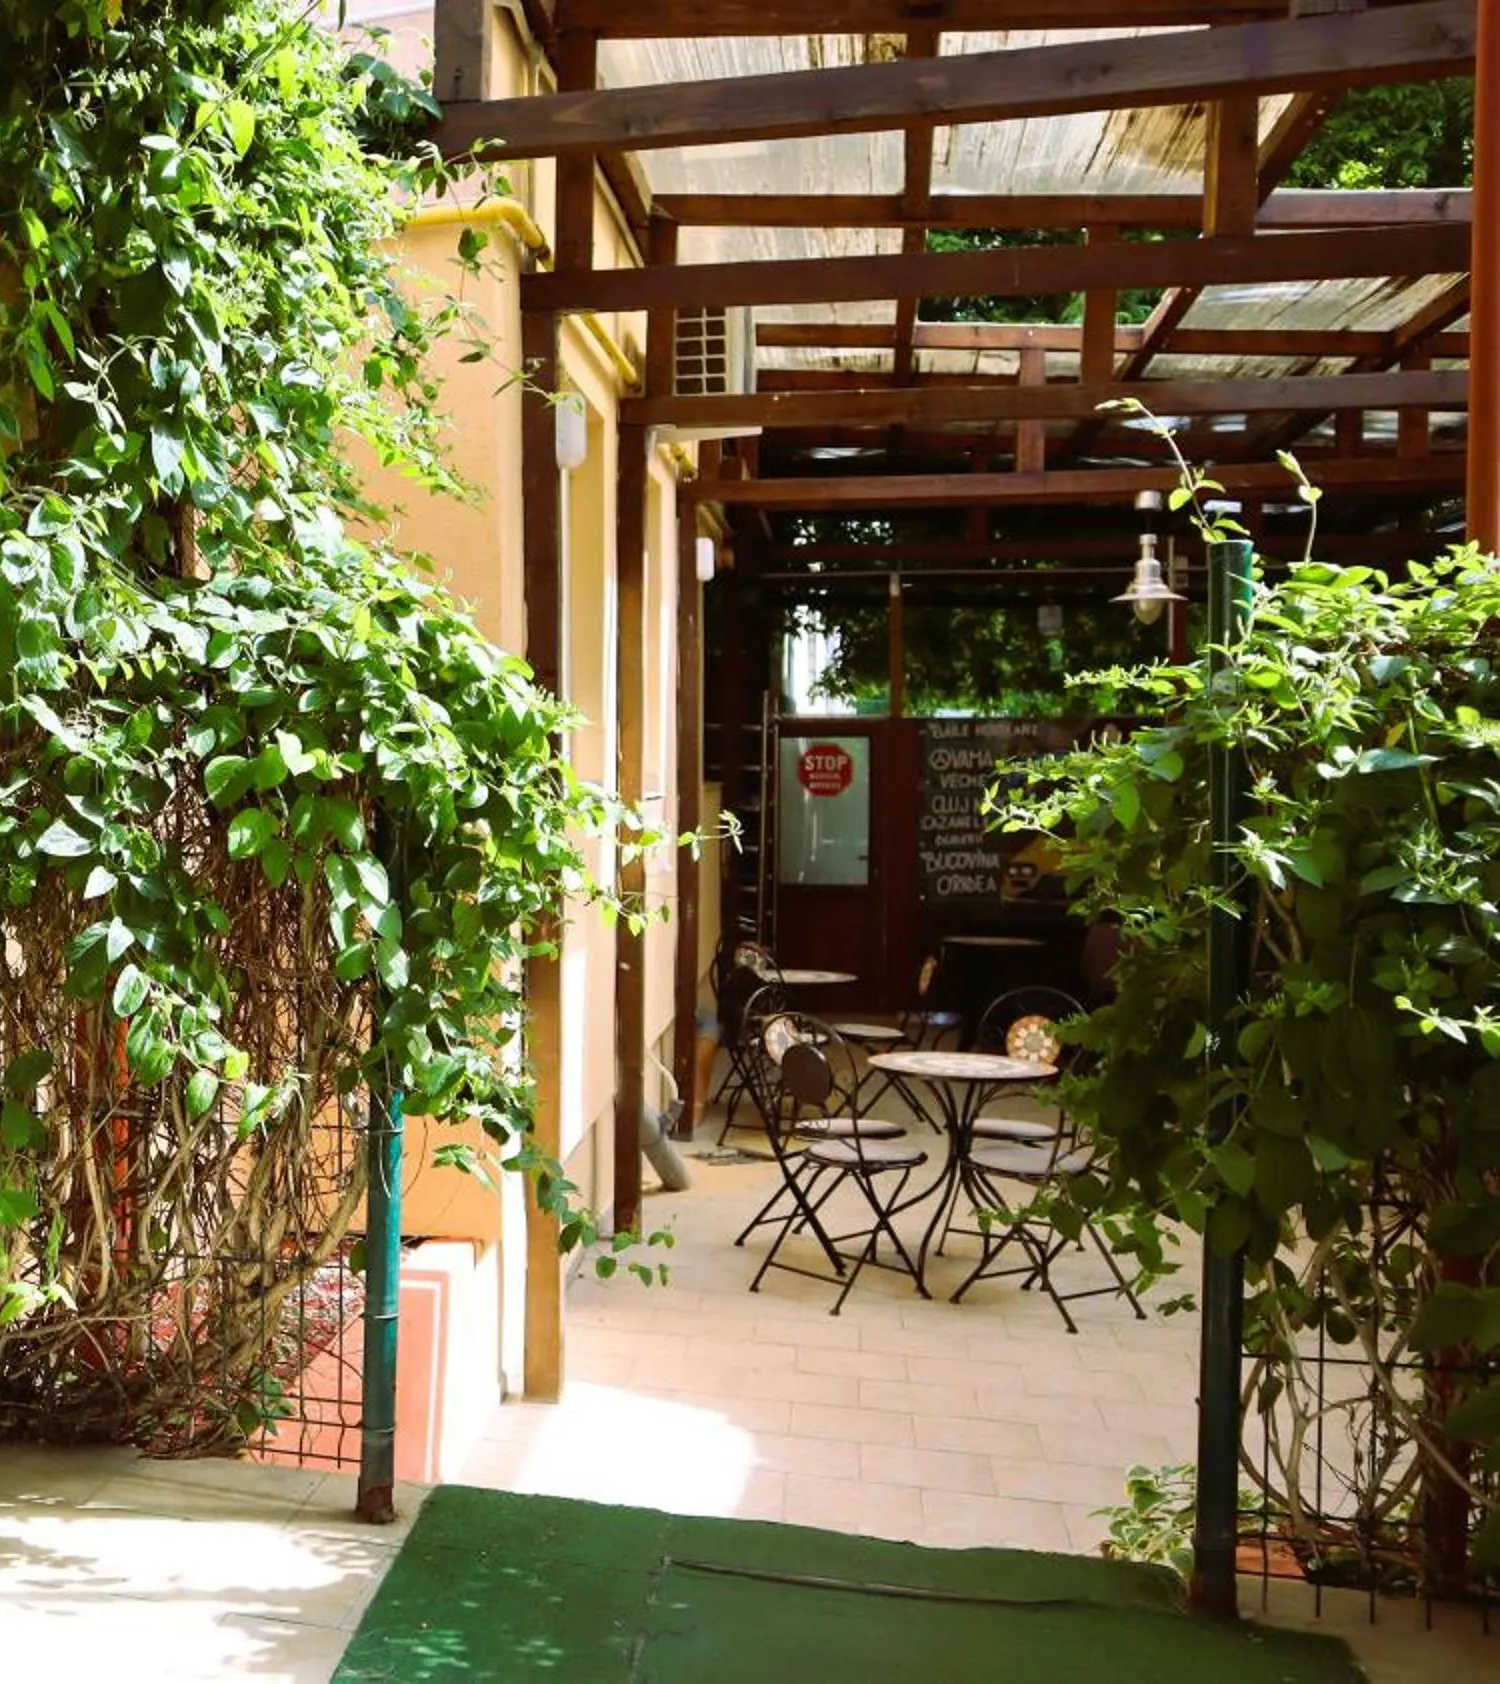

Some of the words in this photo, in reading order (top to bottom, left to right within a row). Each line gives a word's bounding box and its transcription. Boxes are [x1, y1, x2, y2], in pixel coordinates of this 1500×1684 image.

[804, 755, 848, 771] STOP
[950, 750, 993, 770] VAMA
[932, 795, 970, 814] CLUJ
[919, 850, 1000, 873] BUCOVINA
